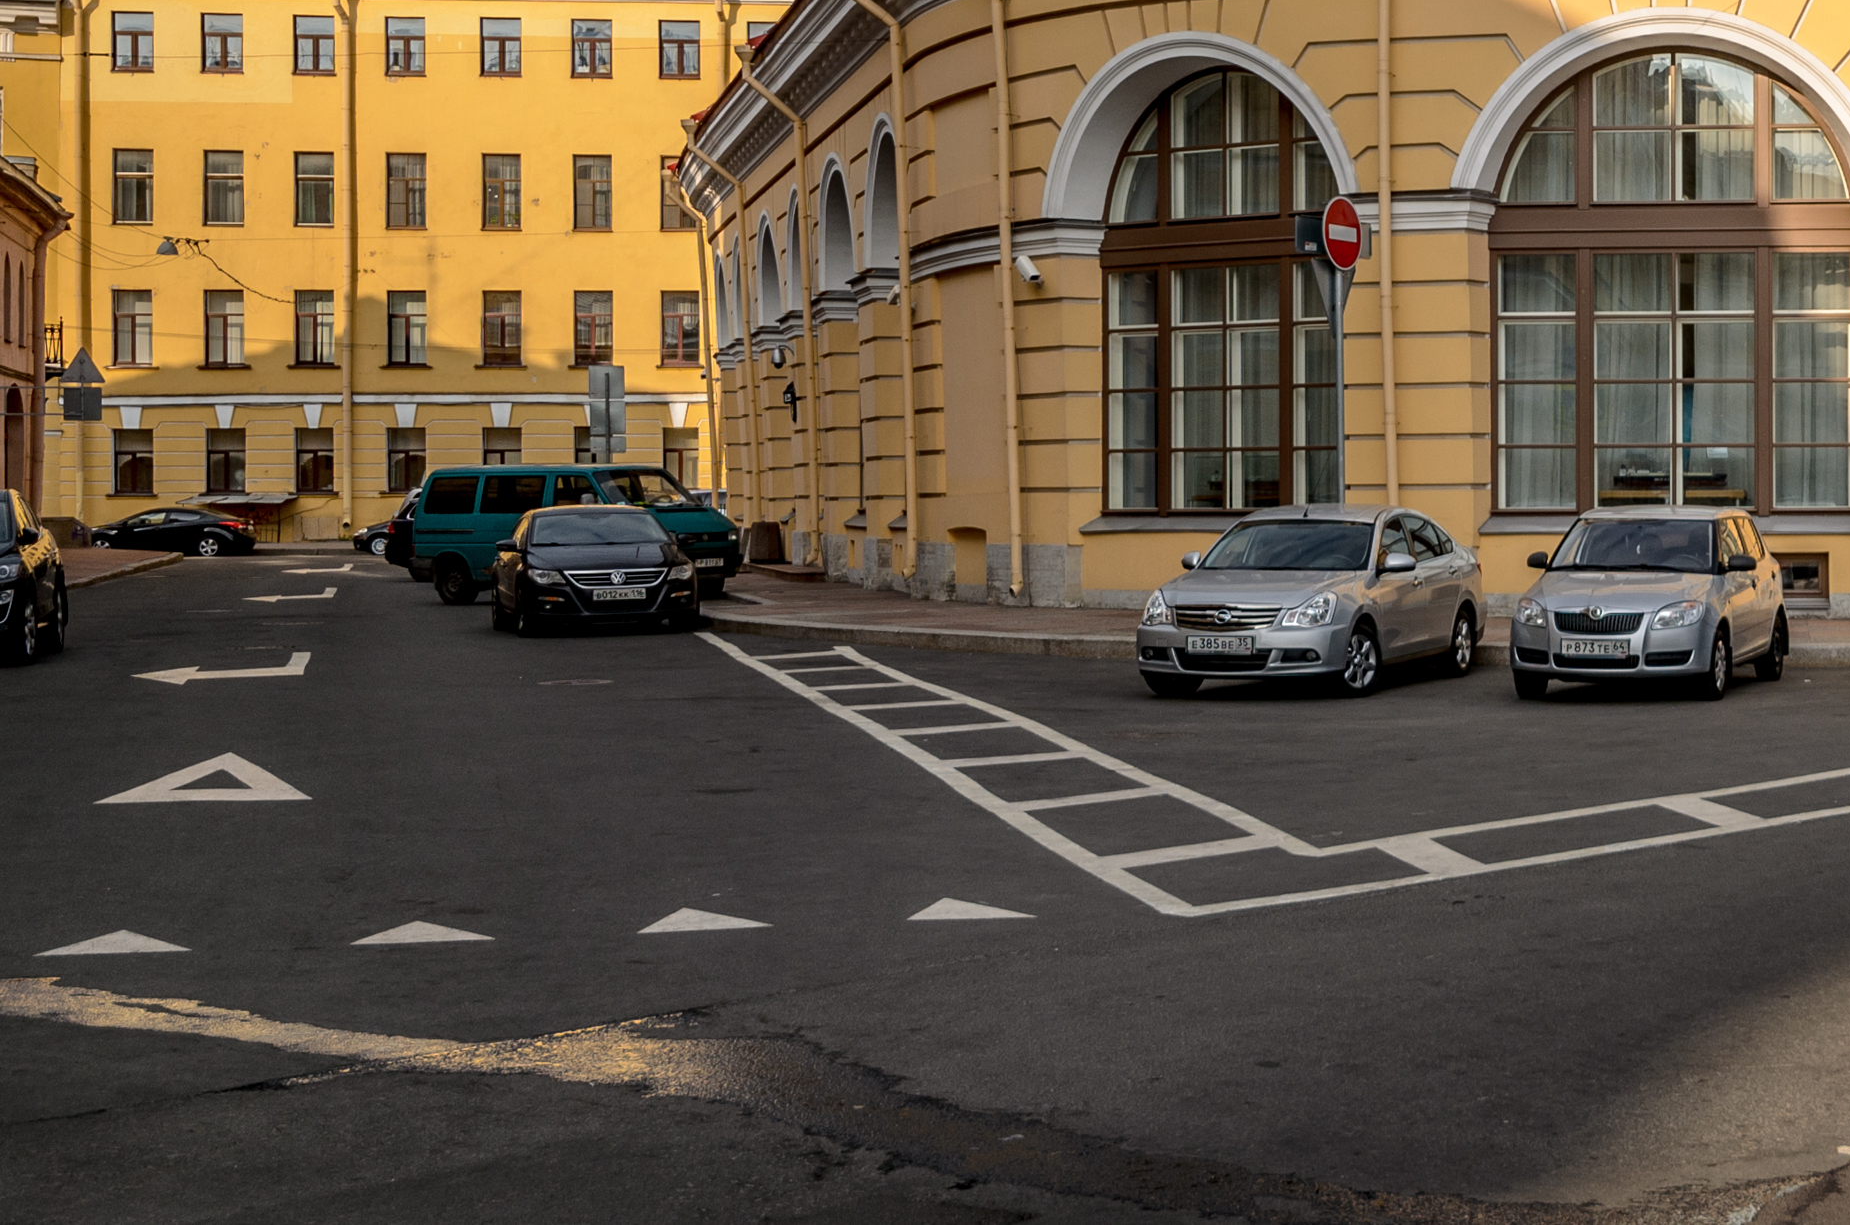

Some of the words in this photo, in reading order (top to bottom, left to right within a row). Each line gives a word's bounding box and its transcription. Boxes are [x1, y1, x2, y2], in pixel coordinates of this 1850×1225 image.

[1192, 638, 1234, 649] Е385ВЕ
[1238, 637, 1248, 646] 35
[1566, 641, 1610, 654] Р873ТЕ
[1613, 642, 1625, 651] 64
